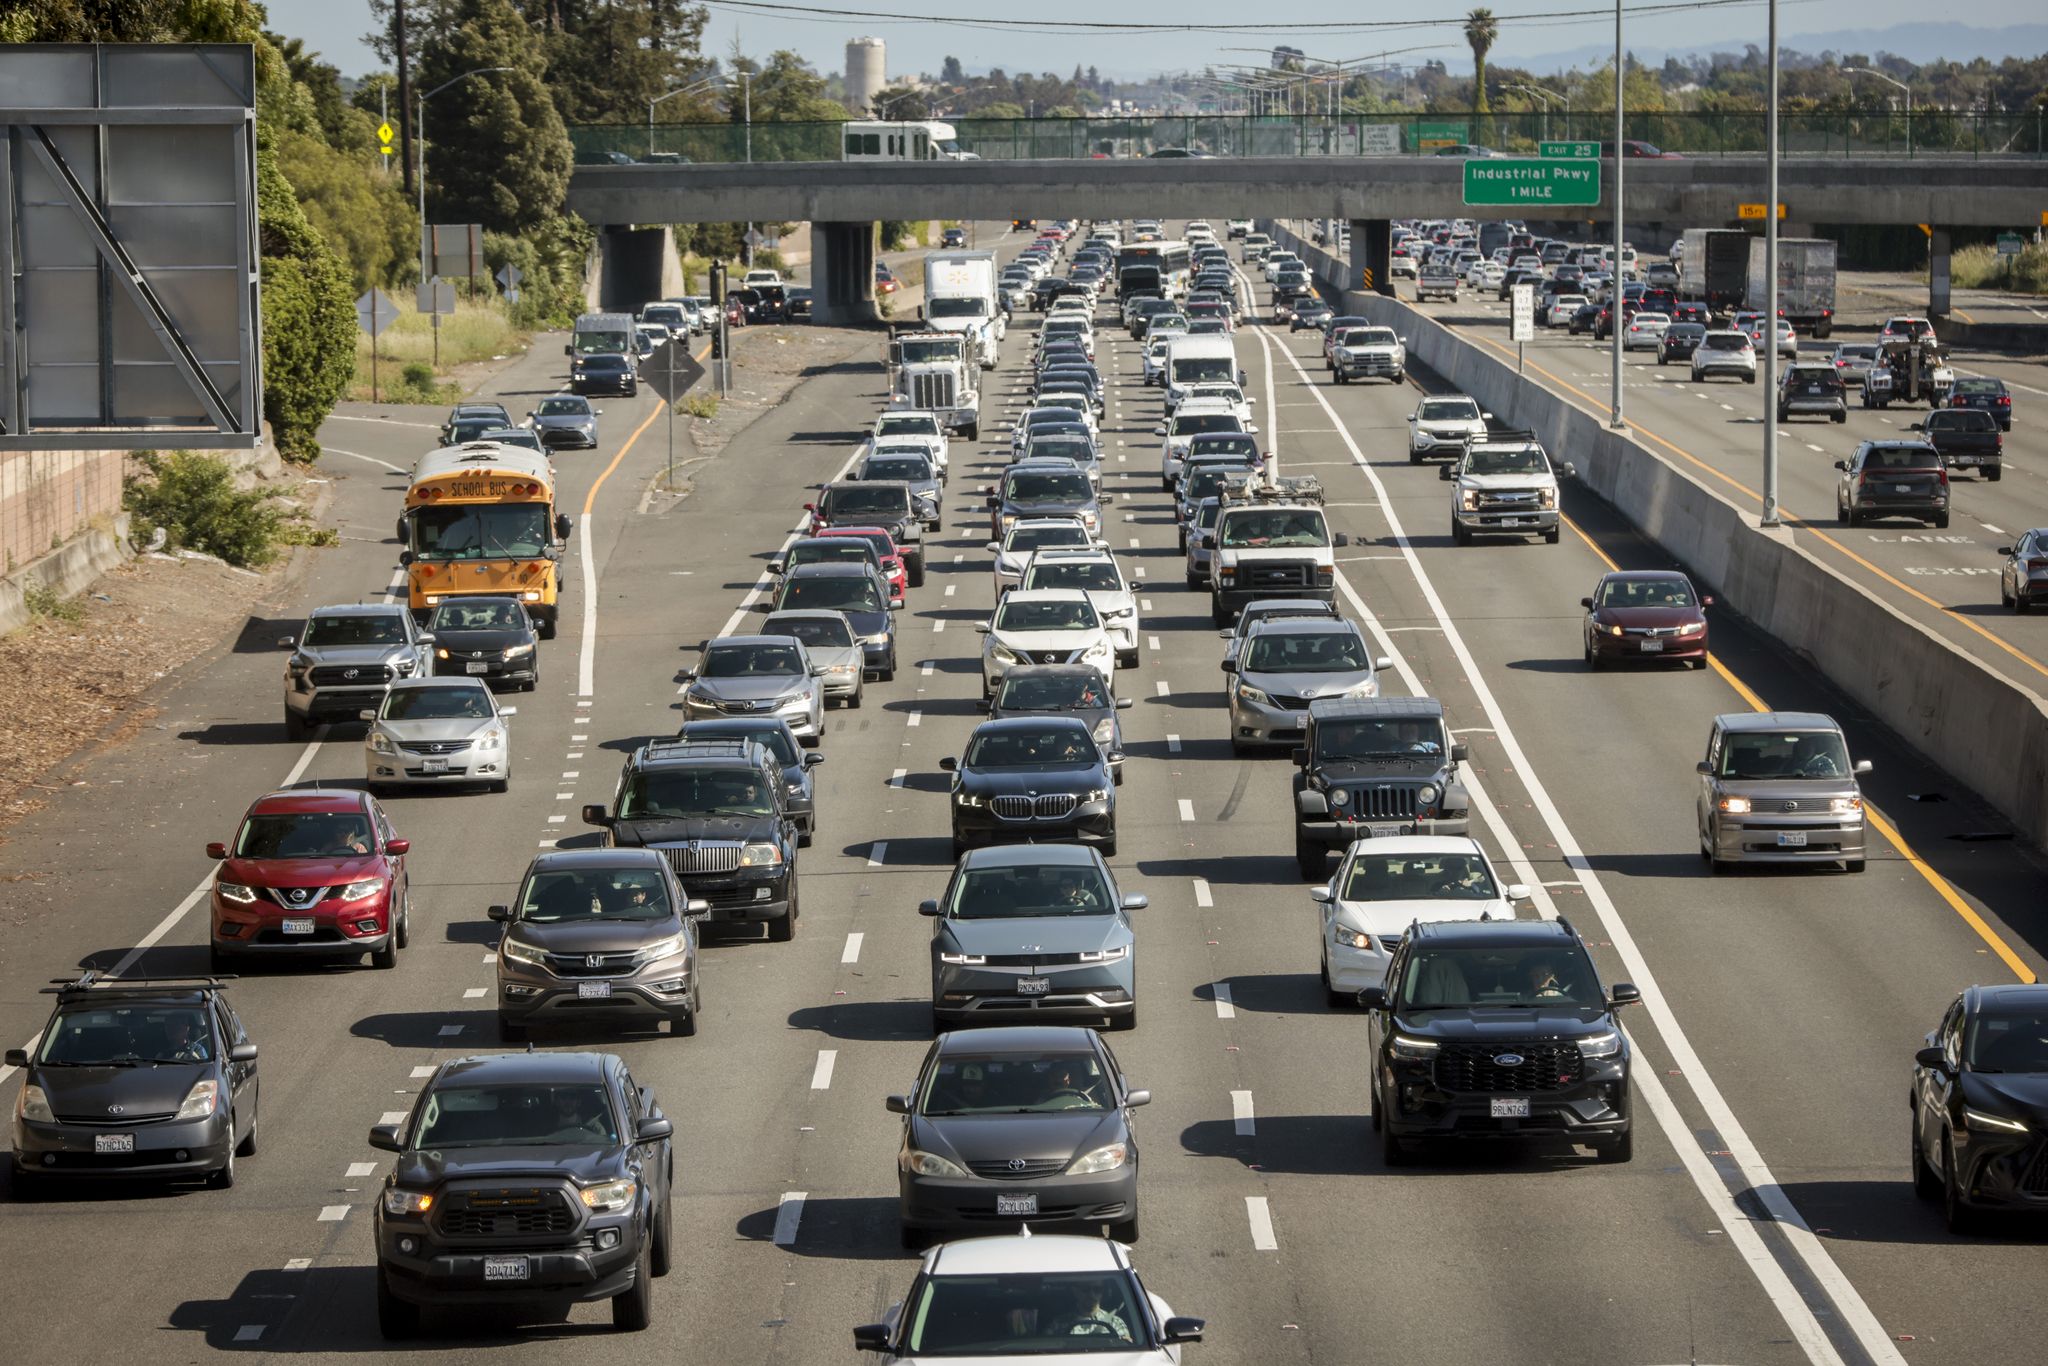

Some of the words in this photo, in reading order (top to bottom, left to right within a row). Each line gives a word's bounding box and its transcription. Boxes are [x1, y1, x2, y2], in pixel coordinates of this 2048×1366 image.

[1548, 146, 1567, 154] EXIT
[1574, 145, 1592, 156] 25
[1472, 168, 1546, 179] Industrial
[1553, 168, 1590, 182] Pkwy
[1511, 187, 1516, 197] 1
[1520, 186, 1552, 197] MILE
[451, 482, 486, 497] SCHOOL
[489, 481, 507, 495] BUS
[1868, 535, 1976, 544] LANE
[1492, 1103, 1528, 1115] 9RLN762
[486, 1265, 526, 1277] 30471M3
